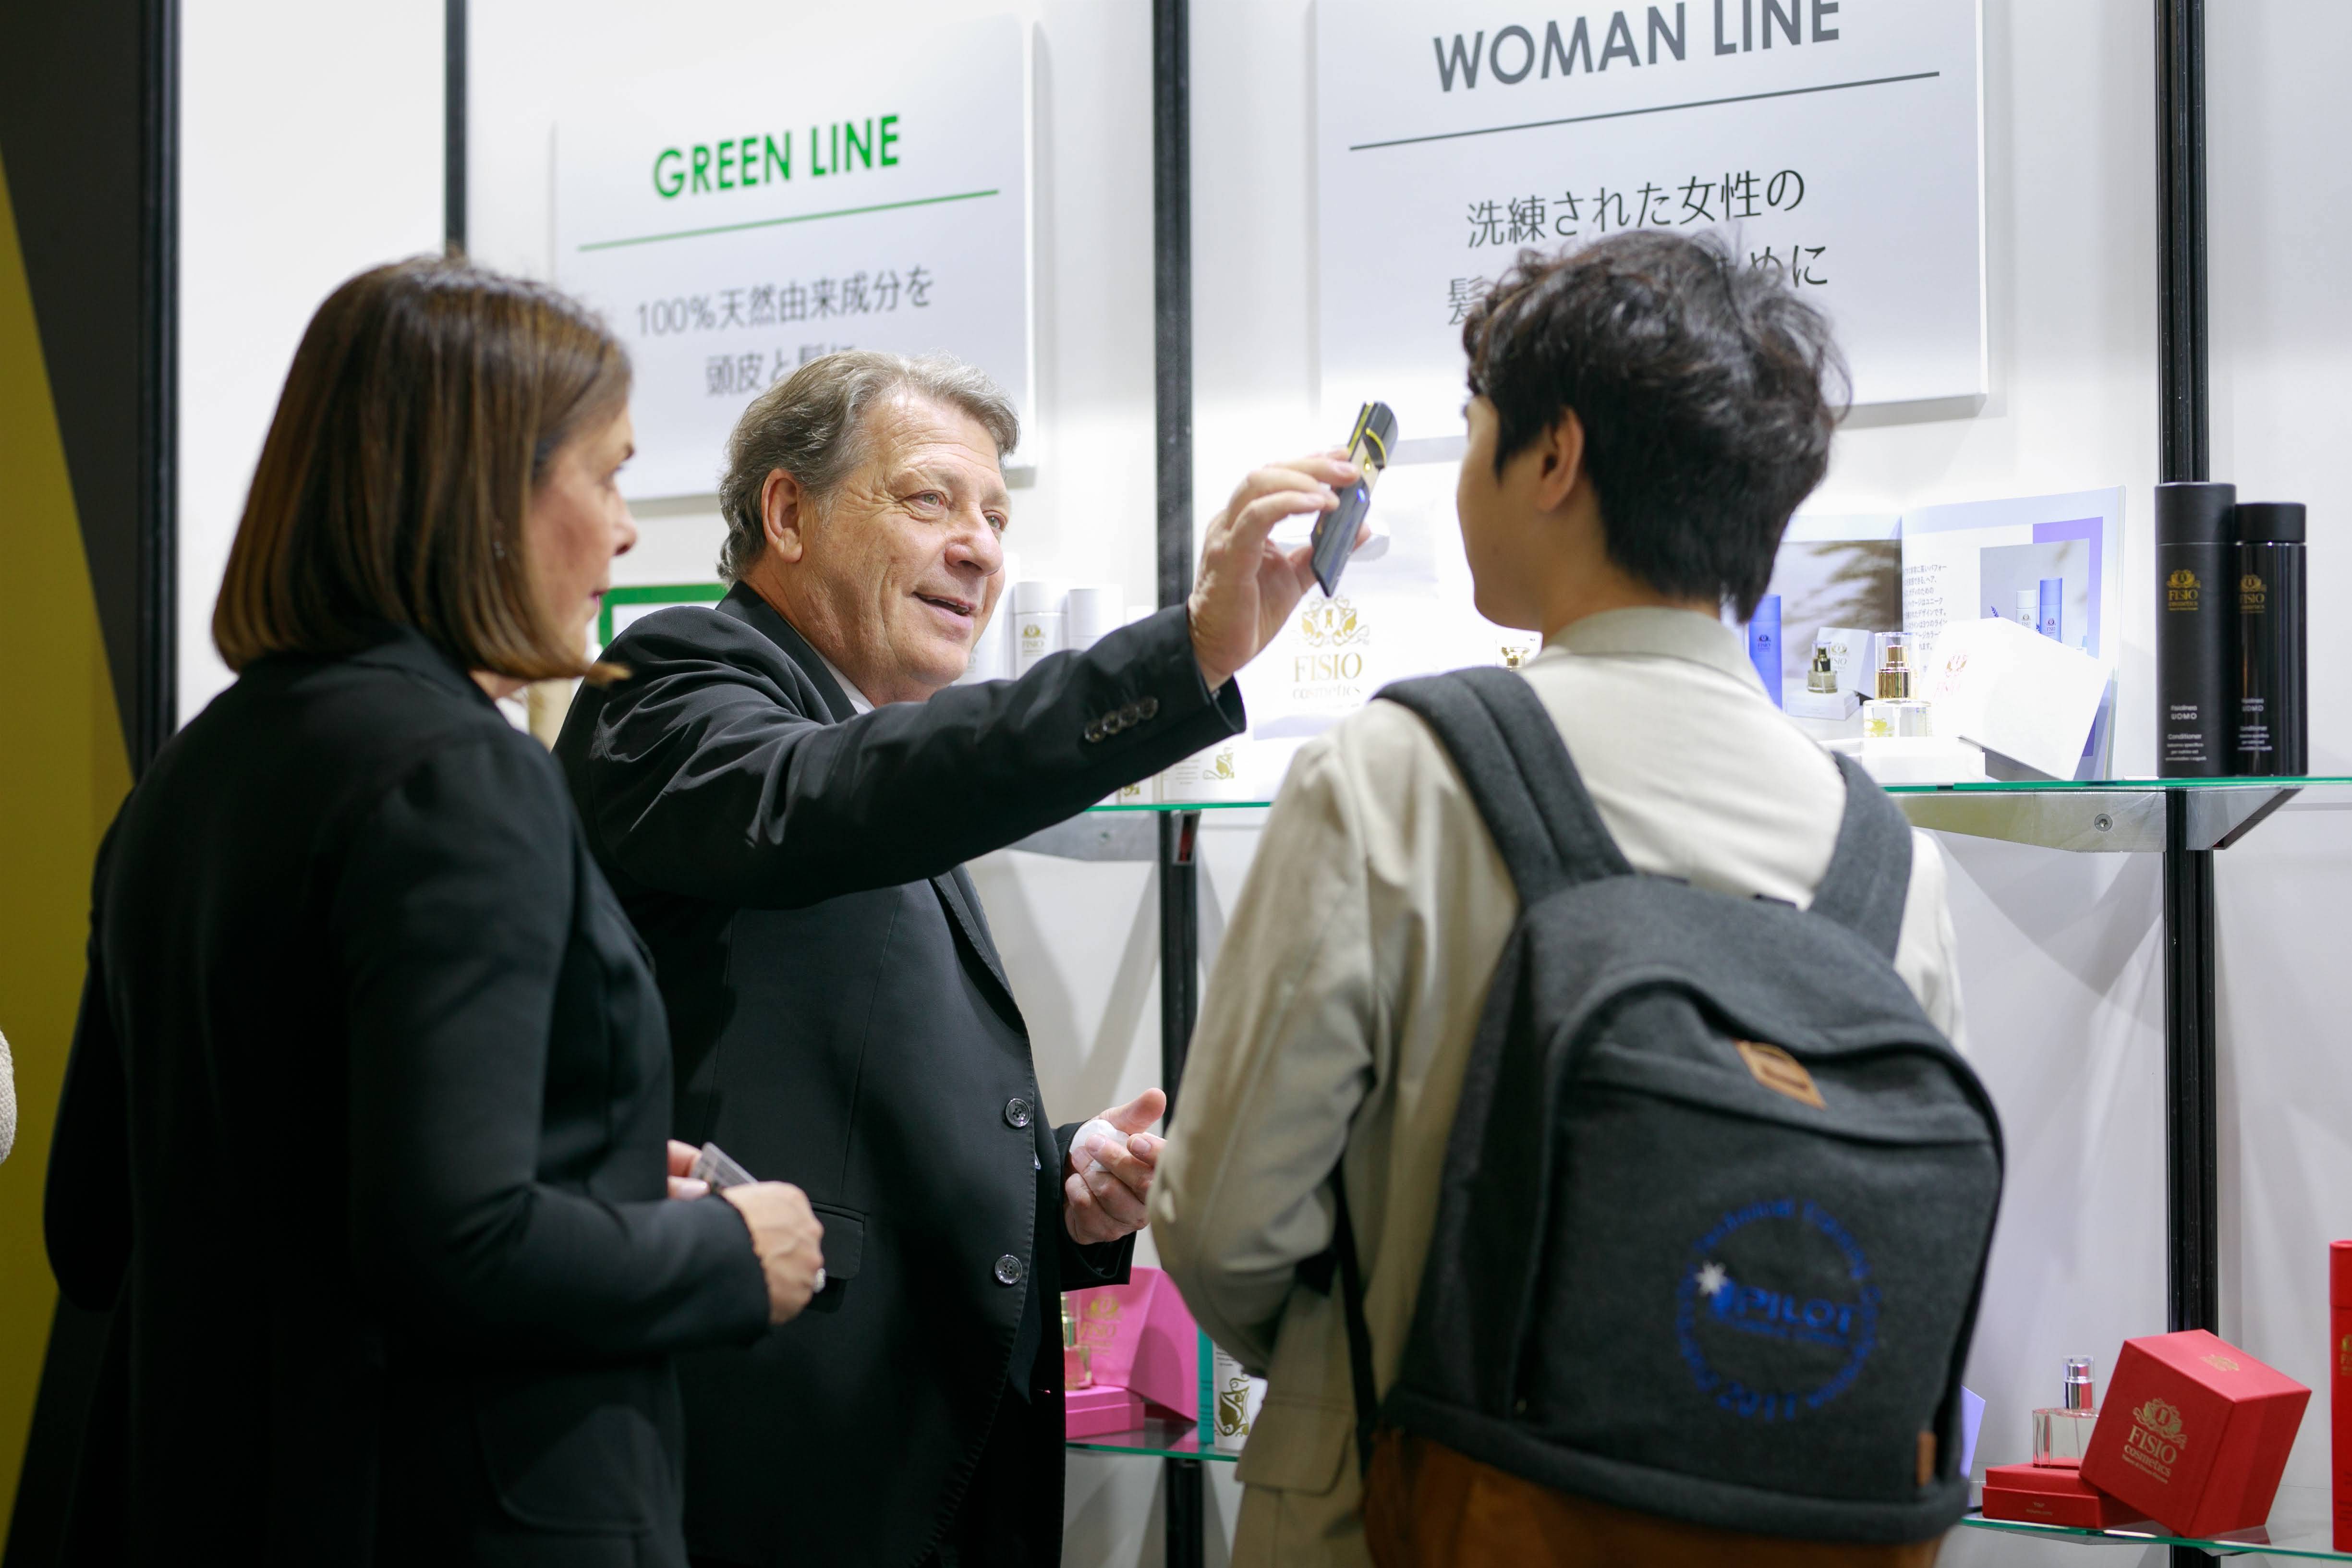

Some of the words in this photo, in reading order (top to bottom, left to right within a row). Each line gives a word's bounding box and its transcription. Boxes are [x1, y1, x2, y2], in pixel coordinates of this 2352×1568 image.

[1433, 1, 1685, 93] WOMAN
[1714, 0, 1840, 56] LINE
[654, 131, 791, 199] GREEN
[810, 114, 899, 177] LINE
[1467, 169, 1806, 248] 洗練された女性の
[637, 265, 934, 336] 100%天然由来成分を
[2168, 589, 2198, 600] FISIO
[1294, 652, 1363, 683] FISIO
[2123, 1444, 2171, 1478] cosmetics
[2127, 1424, 2177, 1464] FISIO
